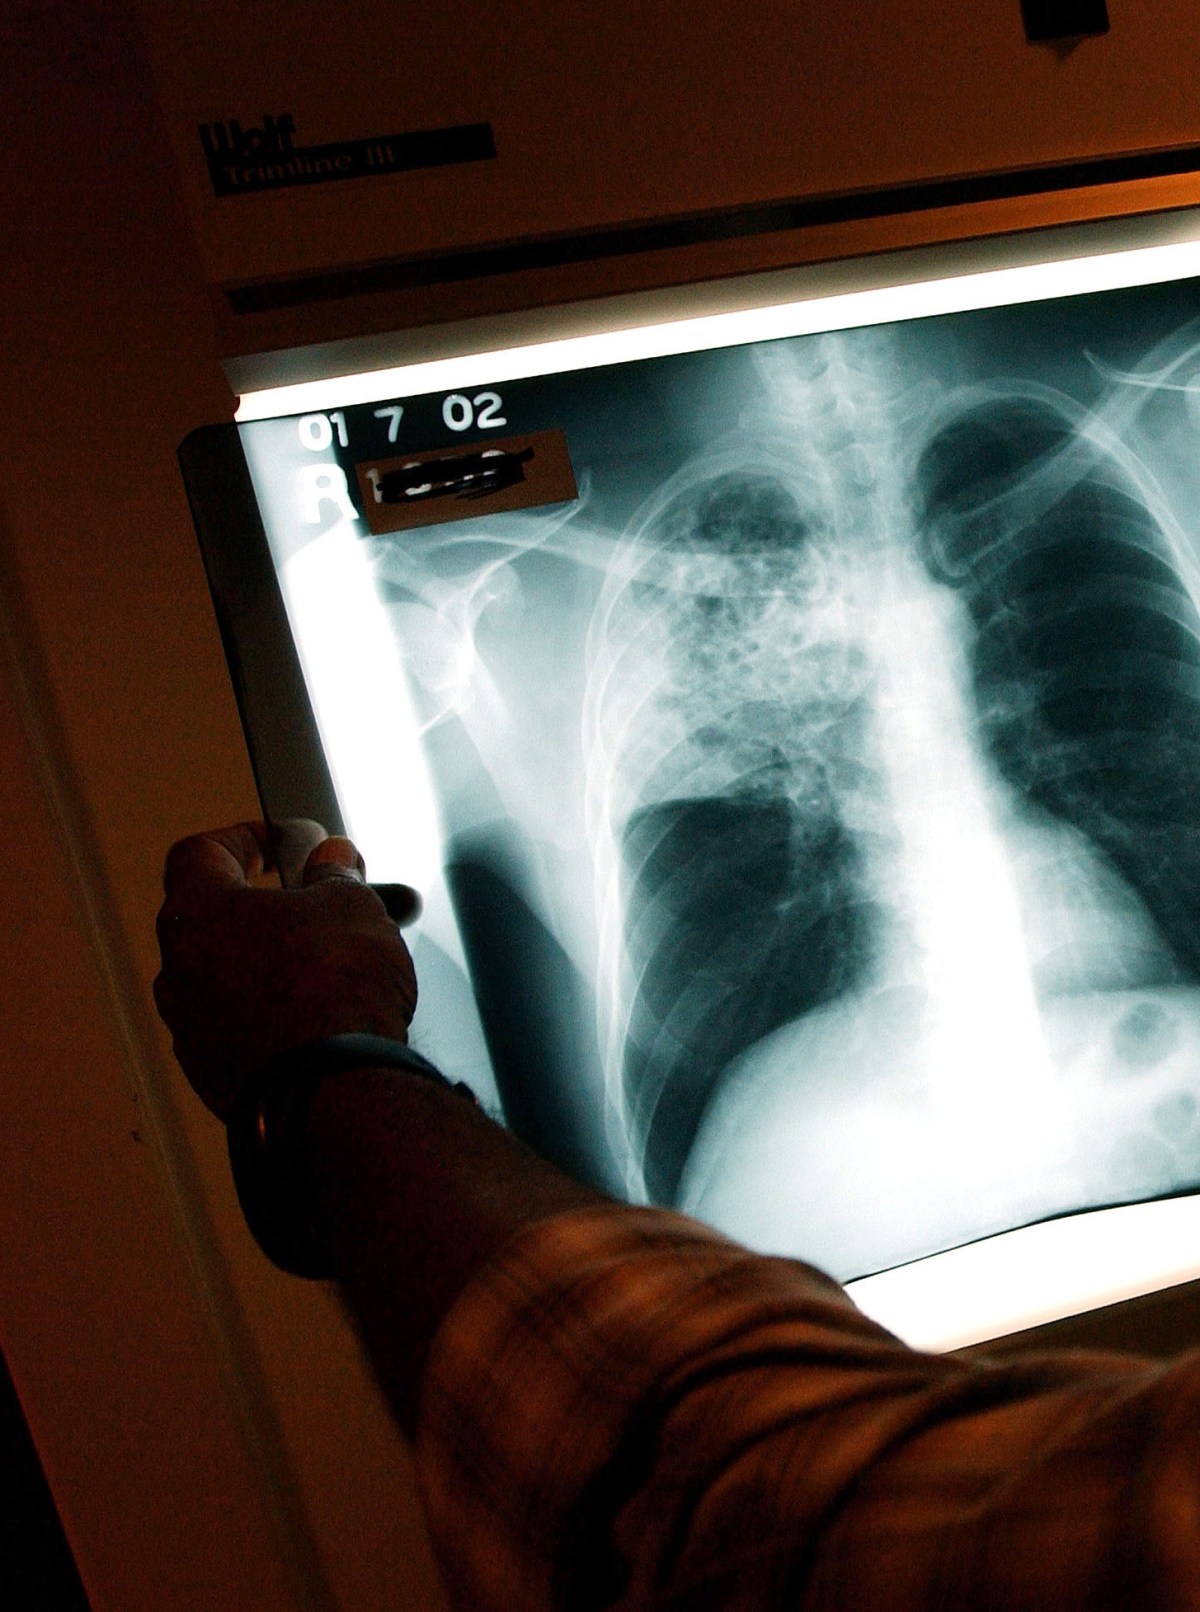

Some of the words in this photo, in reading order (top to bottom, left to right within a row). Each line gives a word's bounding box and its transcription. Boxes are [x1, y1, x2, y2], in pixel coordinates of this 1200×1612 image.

[198, 113, 296, 156] Wolf
[222, 153, 353, 185] Trimline
[365, 143, 397, 167] III
[298, 411, 349, 451] 01
[374, 406, 404, 443] 7
[442, 391, 507, 432] 02
[298, 463, 359, 524] R
